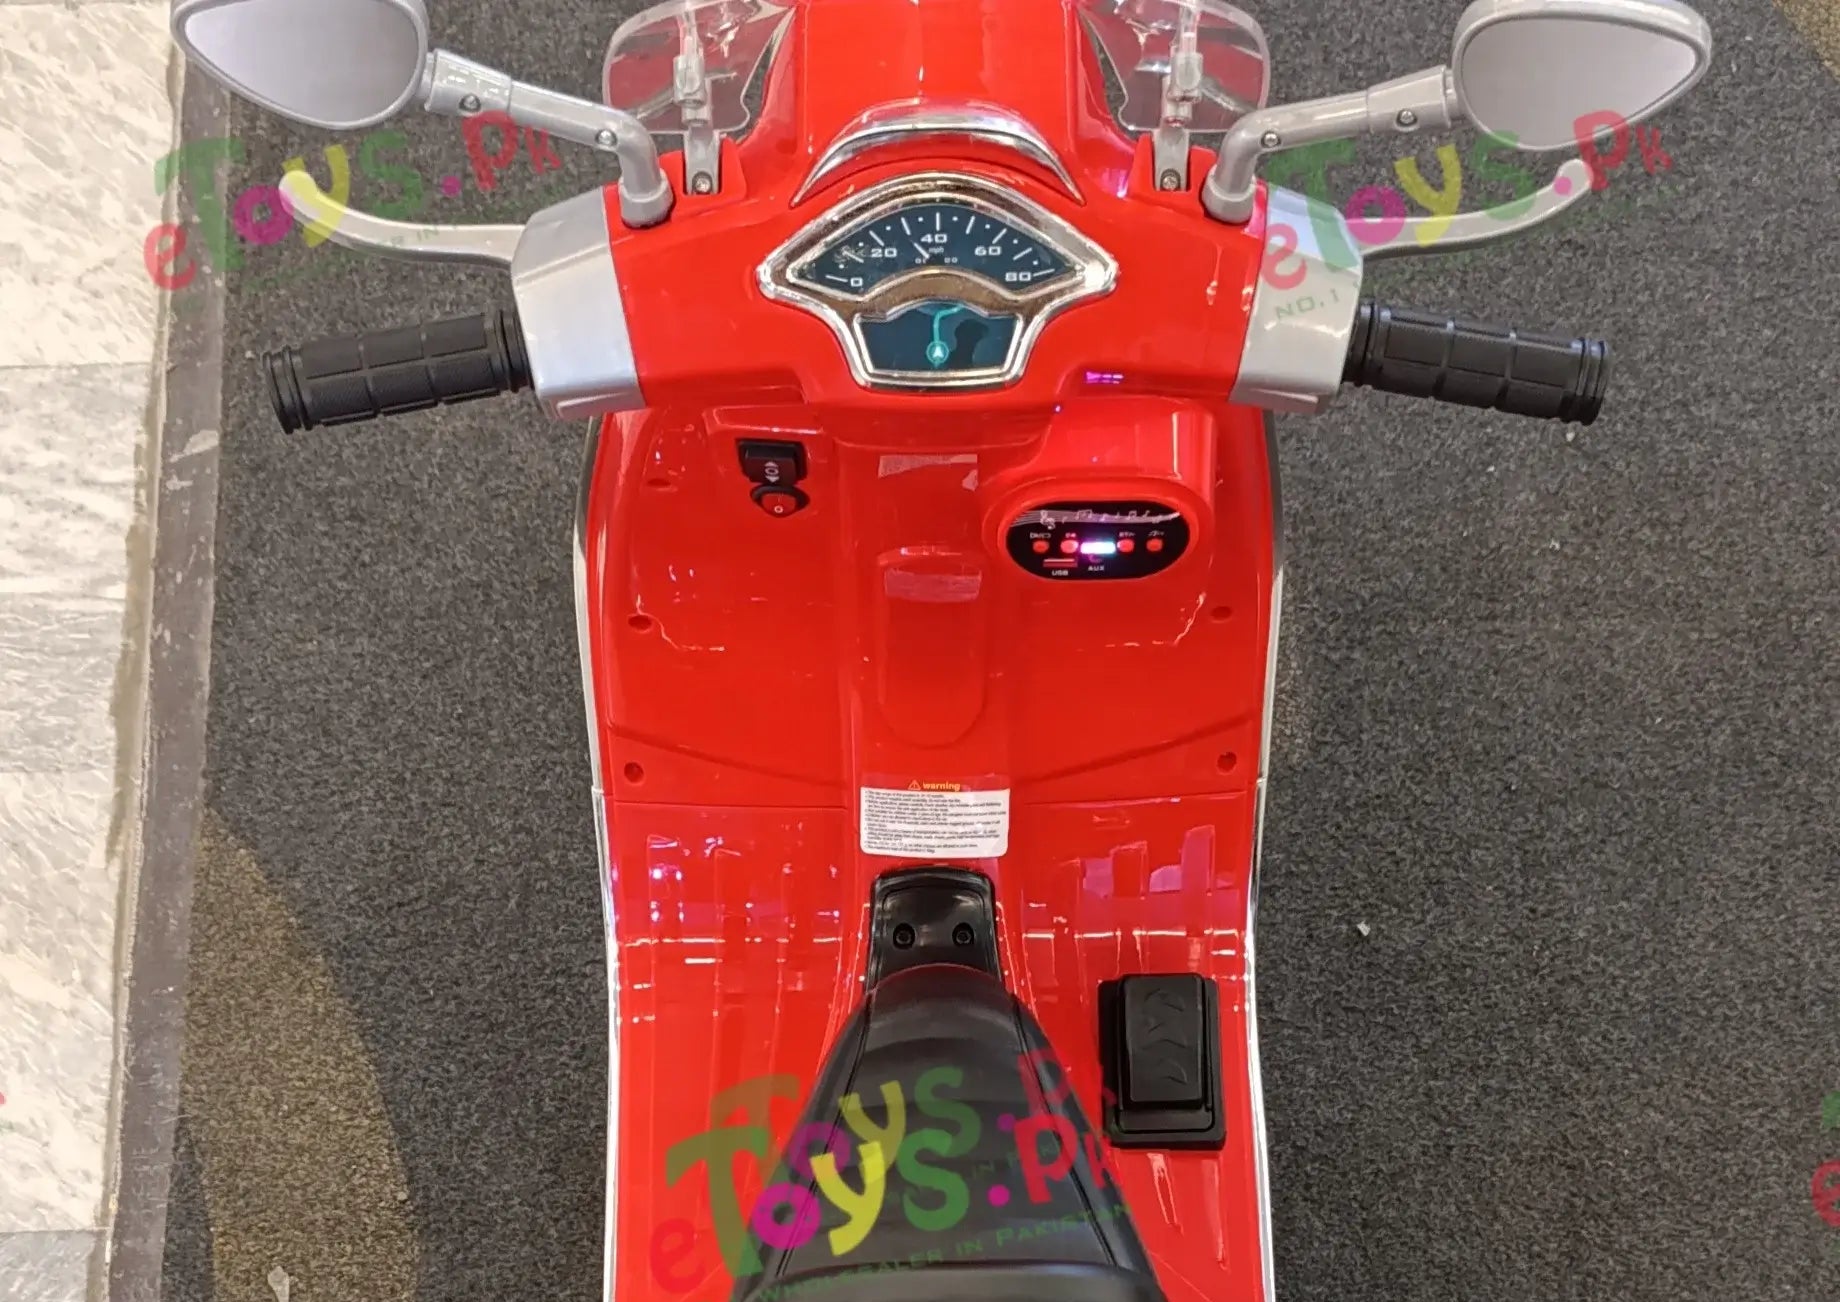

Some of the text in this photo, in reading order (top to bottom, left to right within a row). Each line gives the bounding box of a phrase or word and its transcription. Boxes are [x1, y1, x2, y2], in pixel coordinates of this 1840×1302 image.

[921, 233, 948, 244] 40
[871, 247, 898, 258] 20
[974, 246, 1002, 256] 60
[850, 277, 864, 287] 0
[1005, 272, 1032, 282] 80
[922, 781, 961, 792] warning
